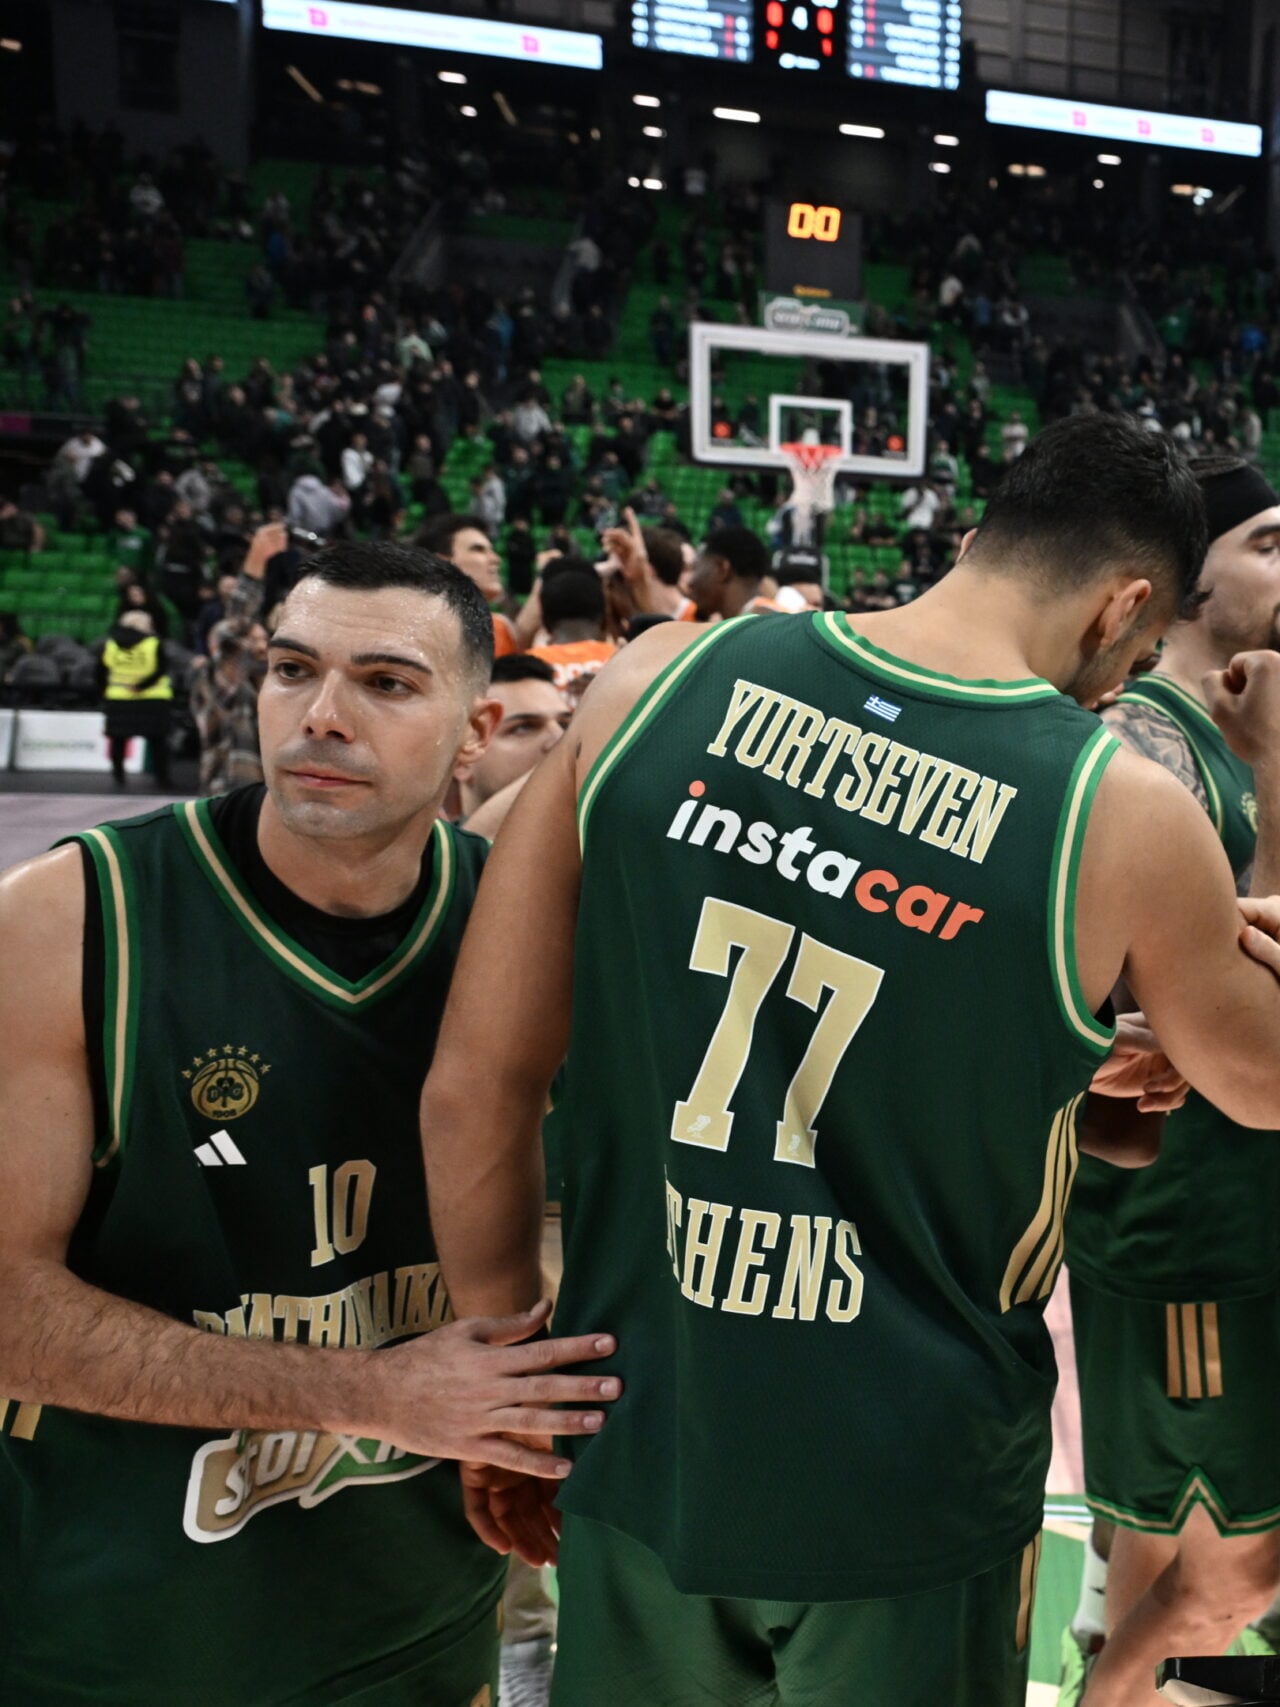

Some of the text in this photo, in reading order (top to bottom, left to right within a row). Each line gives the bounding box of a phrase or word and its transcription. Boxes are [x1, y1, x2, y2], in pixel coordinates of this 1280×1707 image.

[787, 203, 842, 242] 00
[706, 678, 1018, 864] YURTSEVEN
[666, 779, 985, 941] instacar
[670, 896, 886, 1169] 77
[309, 1159, 377, 1267] 10
[664, 1178, 866, 1324] THENS
